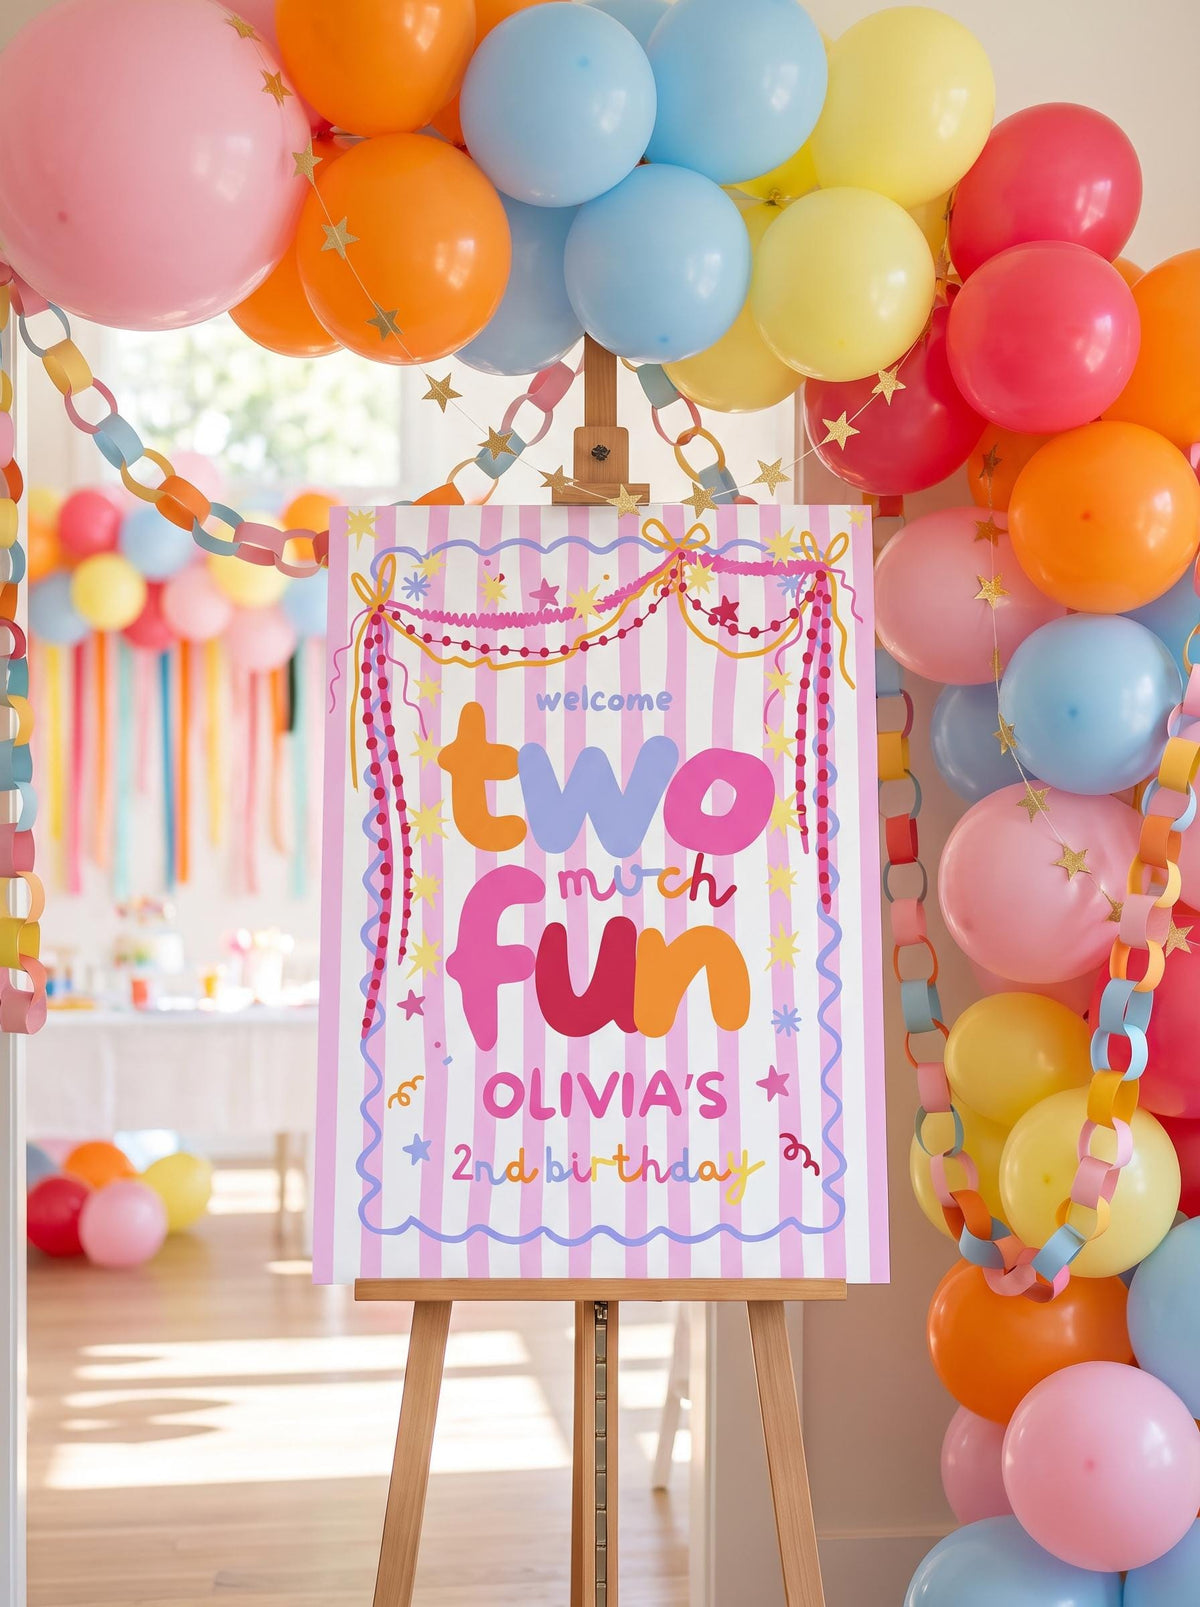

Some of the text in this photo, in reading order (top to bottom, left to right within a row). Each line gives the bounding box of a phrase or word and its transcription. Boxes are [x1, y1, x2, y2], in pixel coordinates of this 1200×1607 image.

[536, 685, 673, 711] welcome
[437, 701, 775, 858] two
[558, 853, 737, 907] much
[445, 864, 751, 1052] fun
[482, 1067, 727, 1120] OLIVIA'S
[452, 1144, 765, 1205] 2nd birthday
